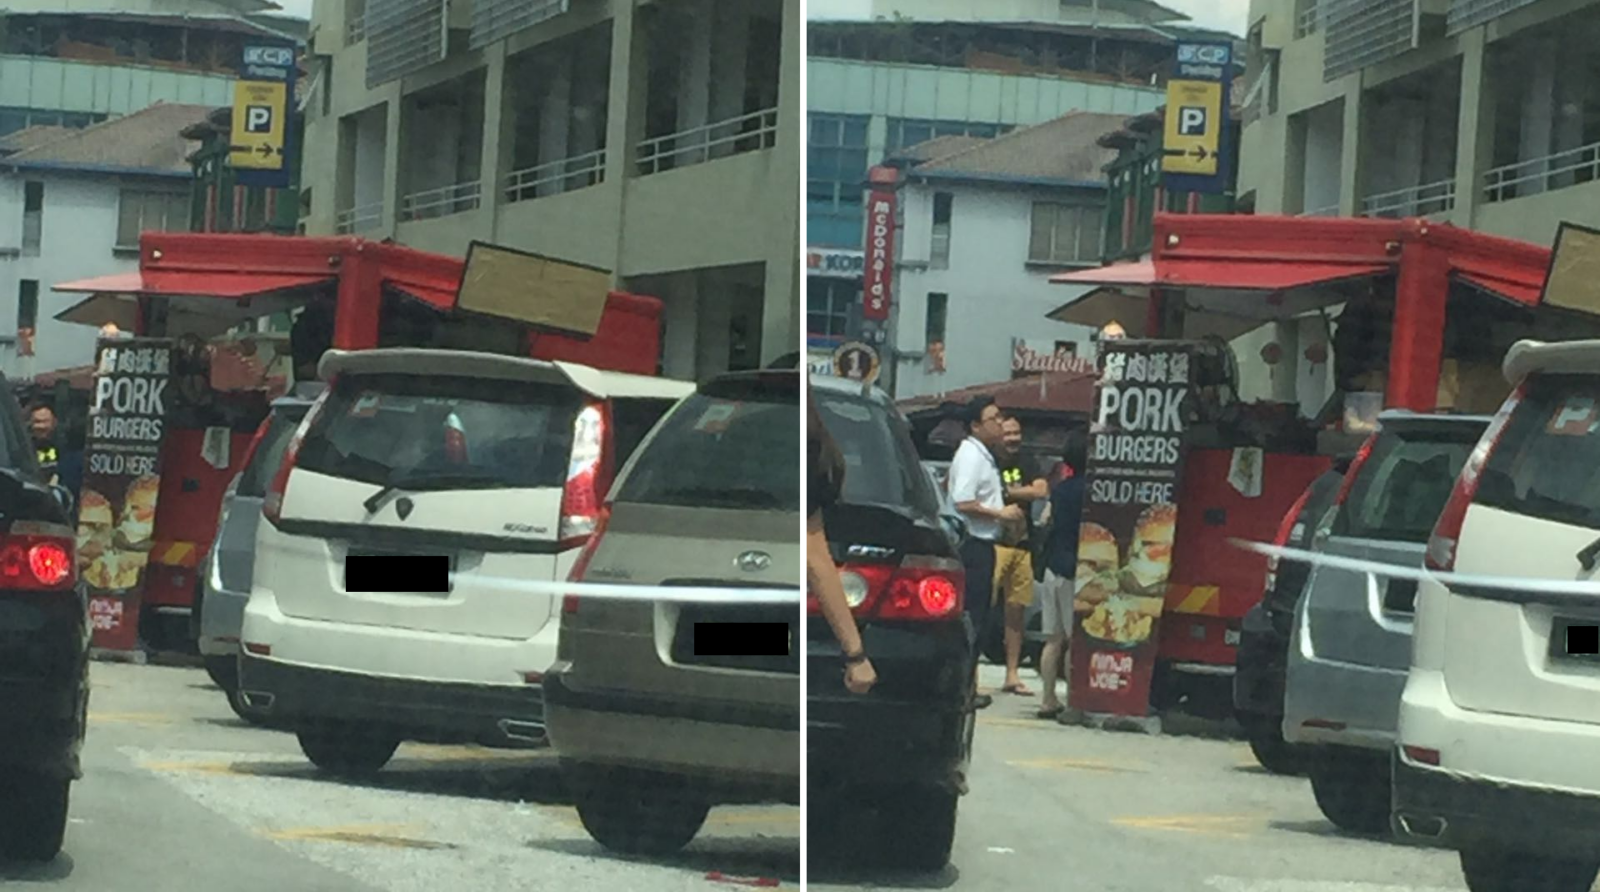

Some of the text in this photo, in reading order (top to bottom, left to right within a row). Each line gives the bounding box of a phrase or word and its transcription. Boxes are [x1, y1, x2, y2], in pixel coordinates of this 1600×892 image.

[248, 107, 270, 132] P
[1181, 107, 1204, 134] P
[871, 200, 890, 310] McDonald's
[95, 376, 168, 415] PORK
[1099, 386, 1188, 432] PORK
[93, 416, 163, 441] BURGERS
[1095, 434, 1180, 464] BURGERS
[90, 453, 157, 476] SOLD HERE
[1091, 480, 1174, 505] SOLD HERE
